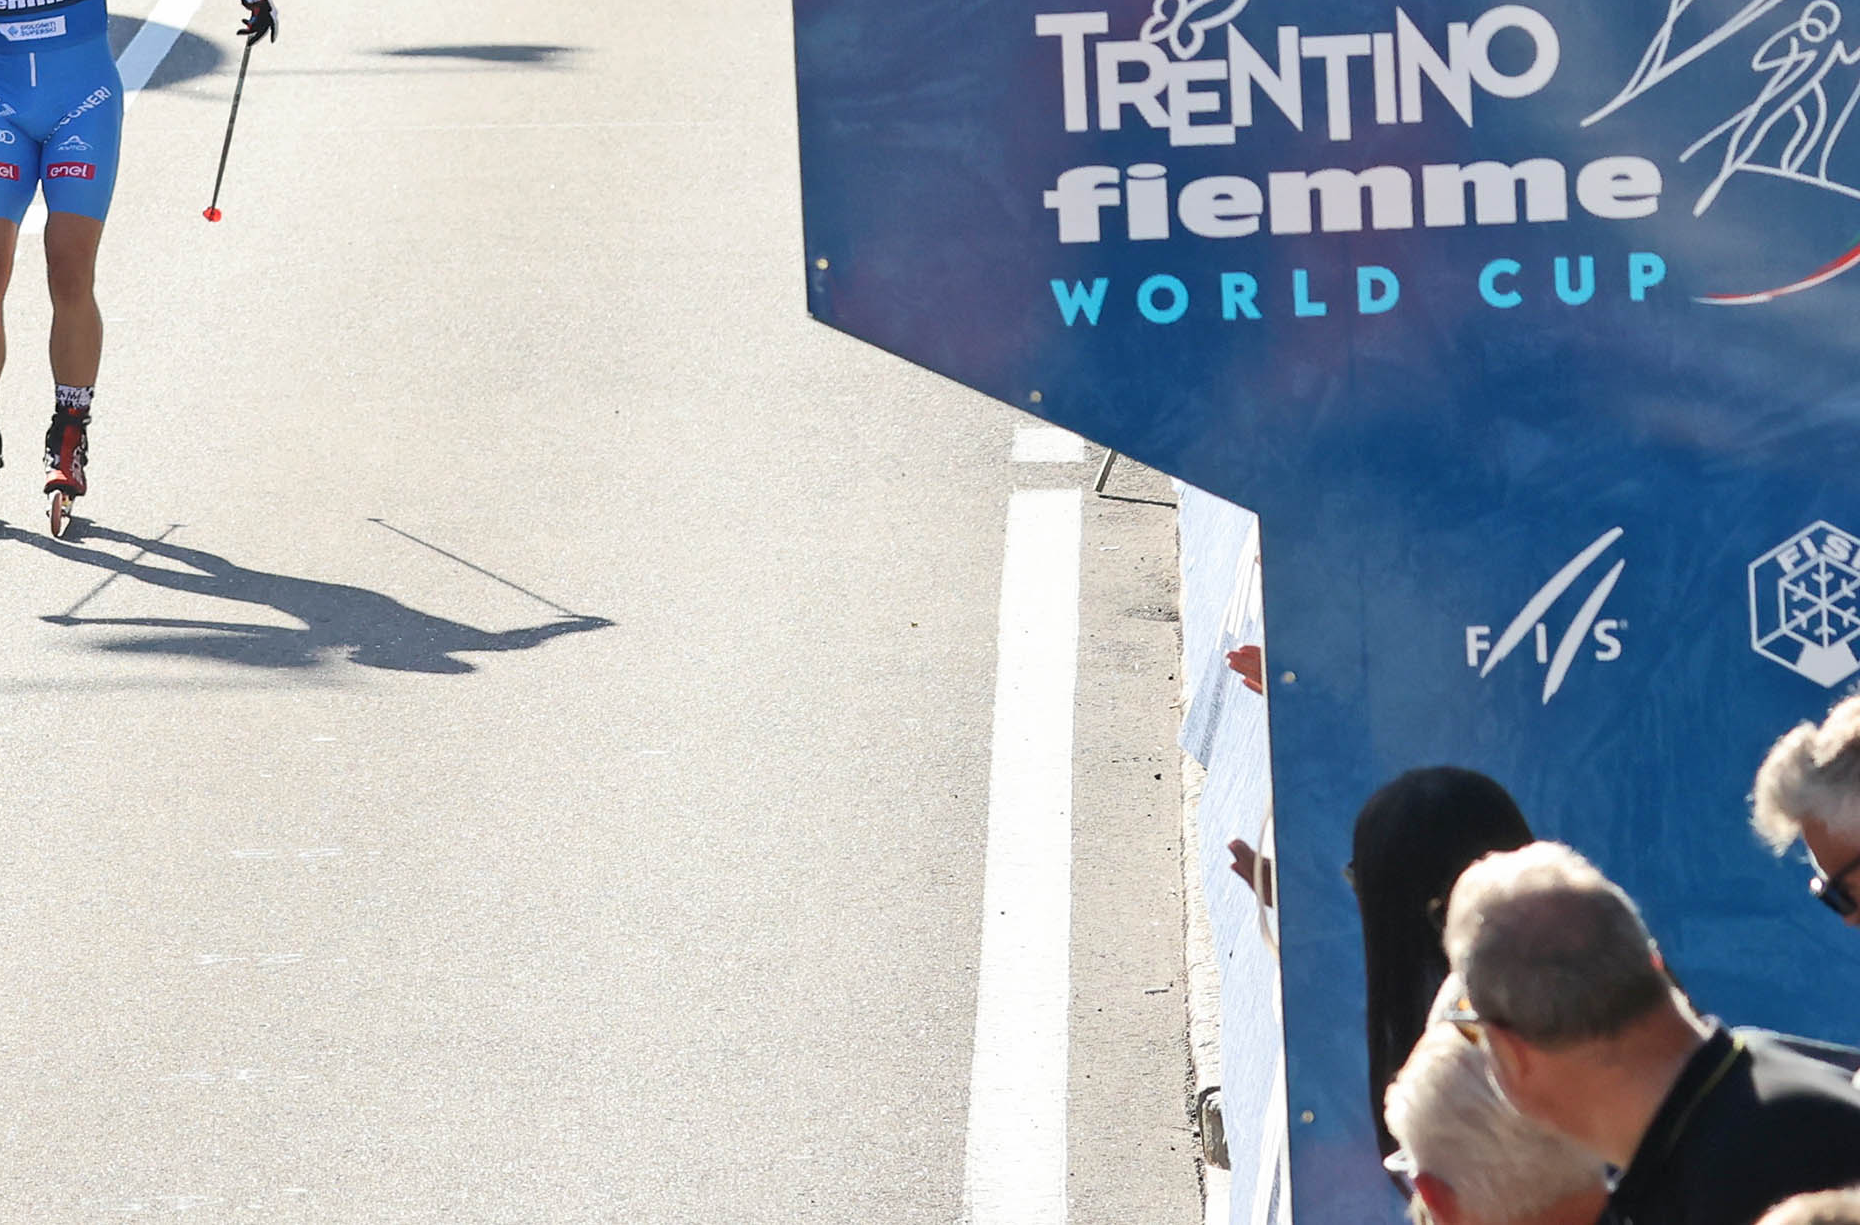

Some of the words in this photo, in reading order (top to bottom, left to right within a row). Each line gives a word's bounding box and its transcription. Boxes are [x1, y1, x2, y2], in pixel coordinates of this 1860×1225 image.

[1035, 4, 1561, 146] TRENTINO
[50, 164, 88, 178] enel
[1043, 154, 1663, 243] fiemme
[1051, 265, 1401, 326] WORLD
[1478, 251, 1668, 310] CUP
[1465, 618, 1622, 667] FIS
